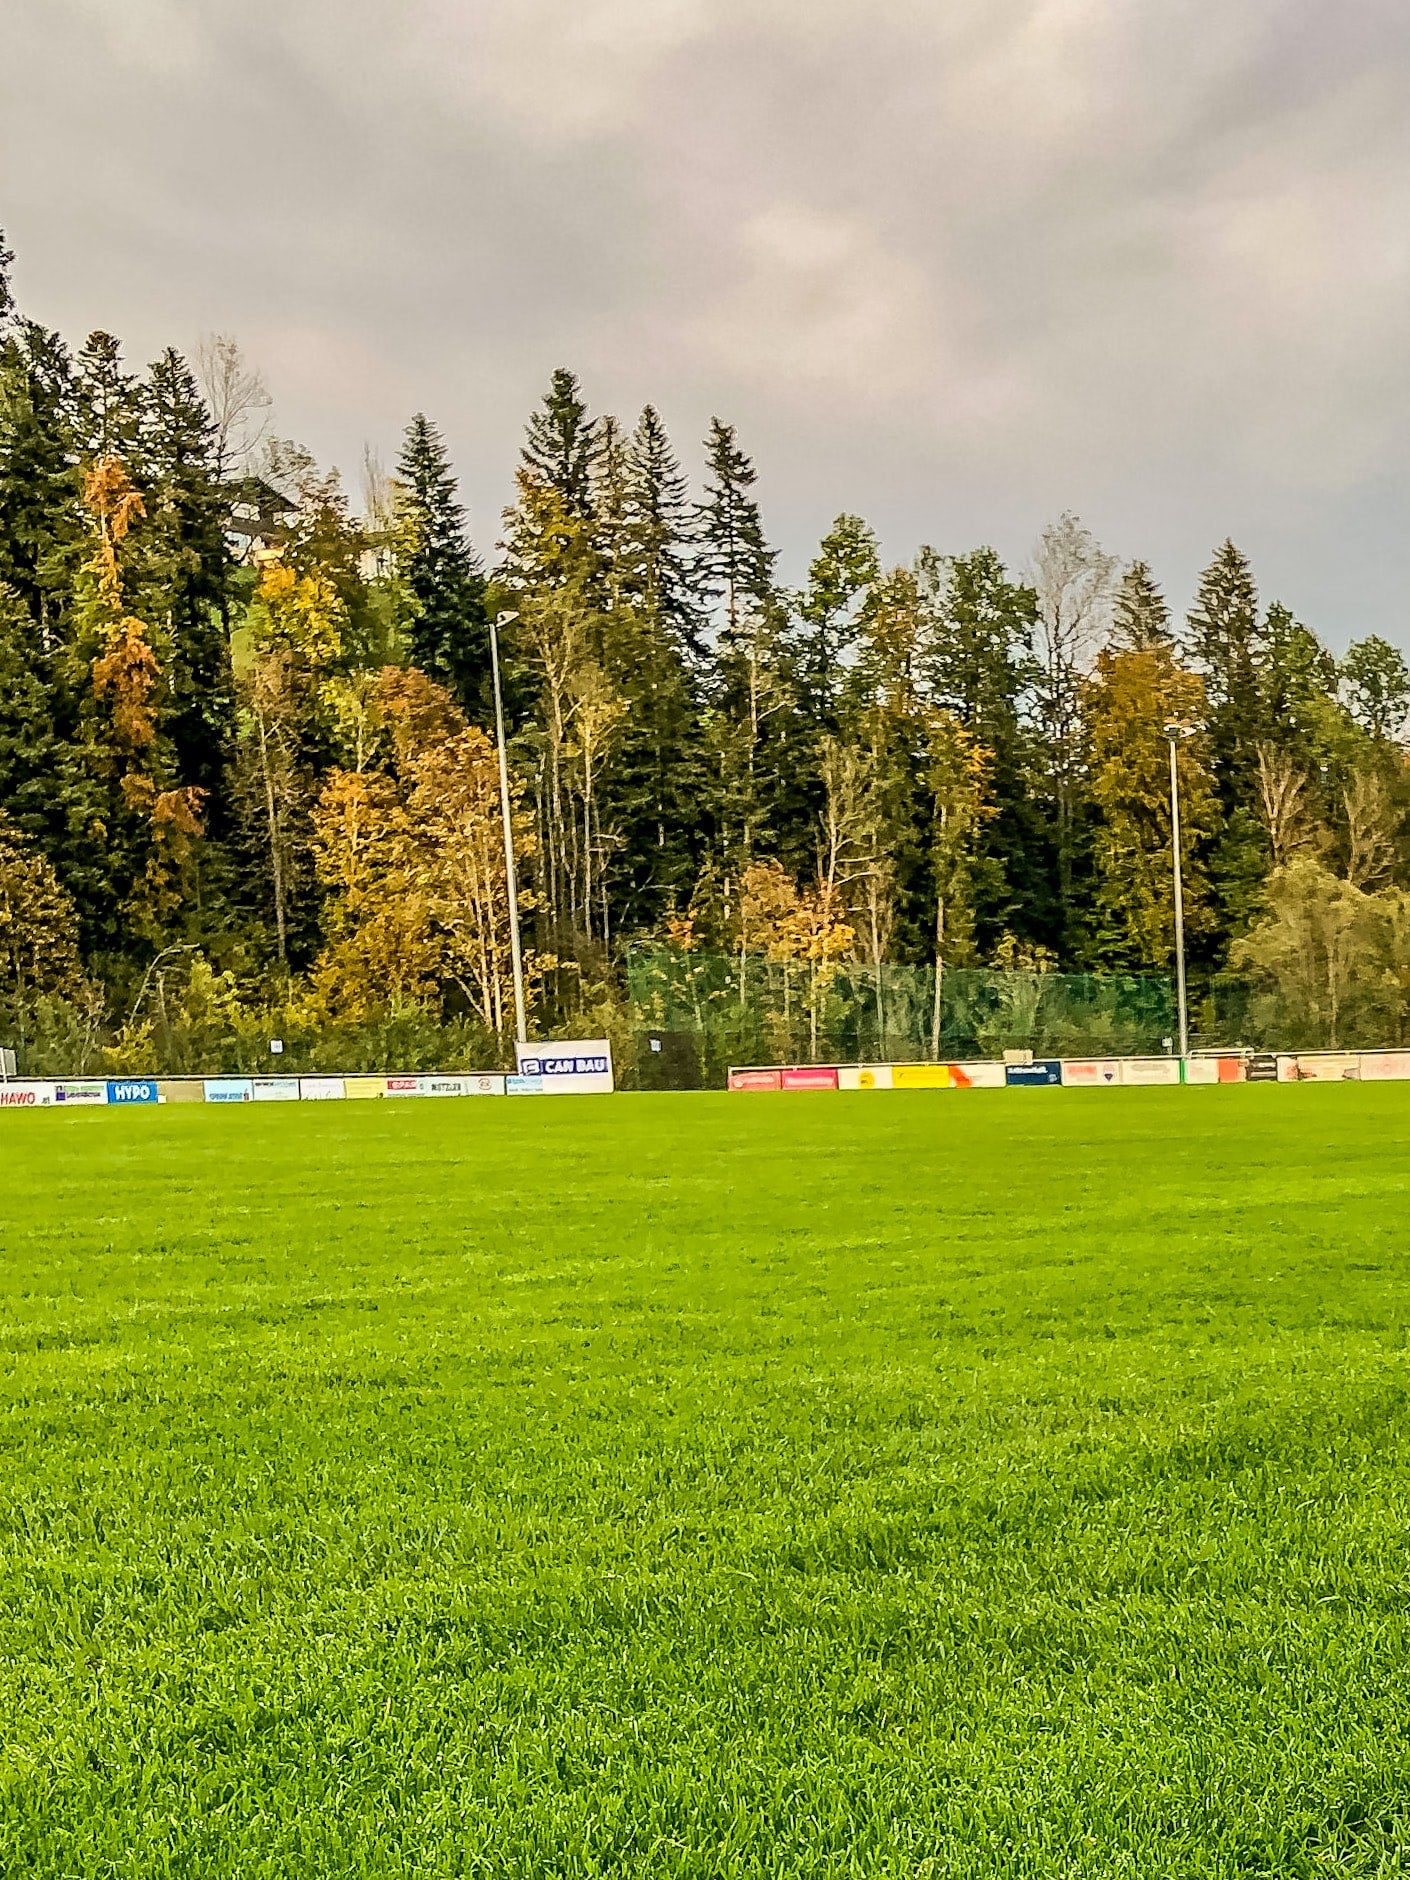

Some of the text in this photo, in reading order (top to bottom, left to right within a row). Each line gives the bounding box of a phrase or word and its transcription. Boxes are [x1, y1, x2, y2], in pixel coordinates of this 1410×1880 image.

[545, 1060, 574, 1073] CAN
[576, 1059, 605, 1072] BAU
[0, 1092, 35, 1105] HAWO
[114, 1085, 151, 1100] HYPO
